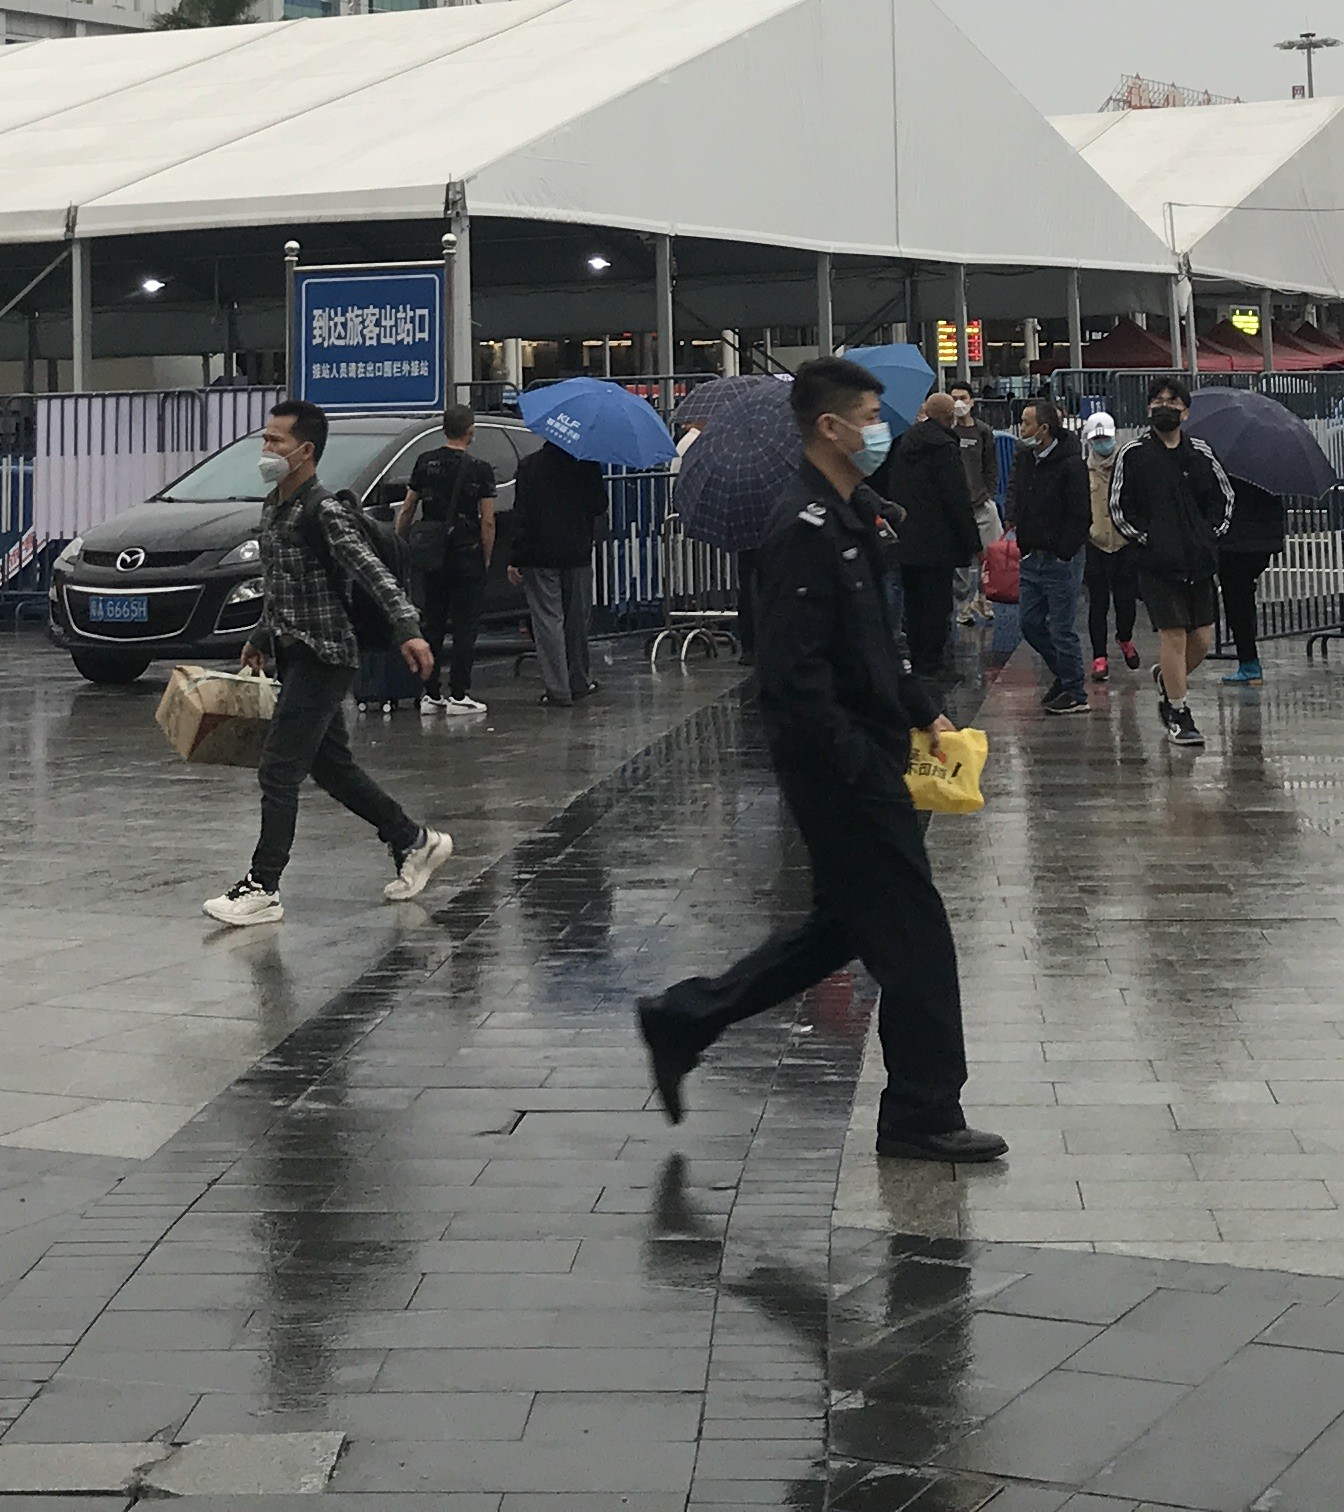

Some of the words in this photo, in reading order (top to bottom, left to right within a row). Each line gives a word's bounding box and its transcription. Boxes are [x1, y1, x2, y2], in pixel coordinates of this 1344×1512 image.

[312, 303, 430, 349] 到达旅客出站口
